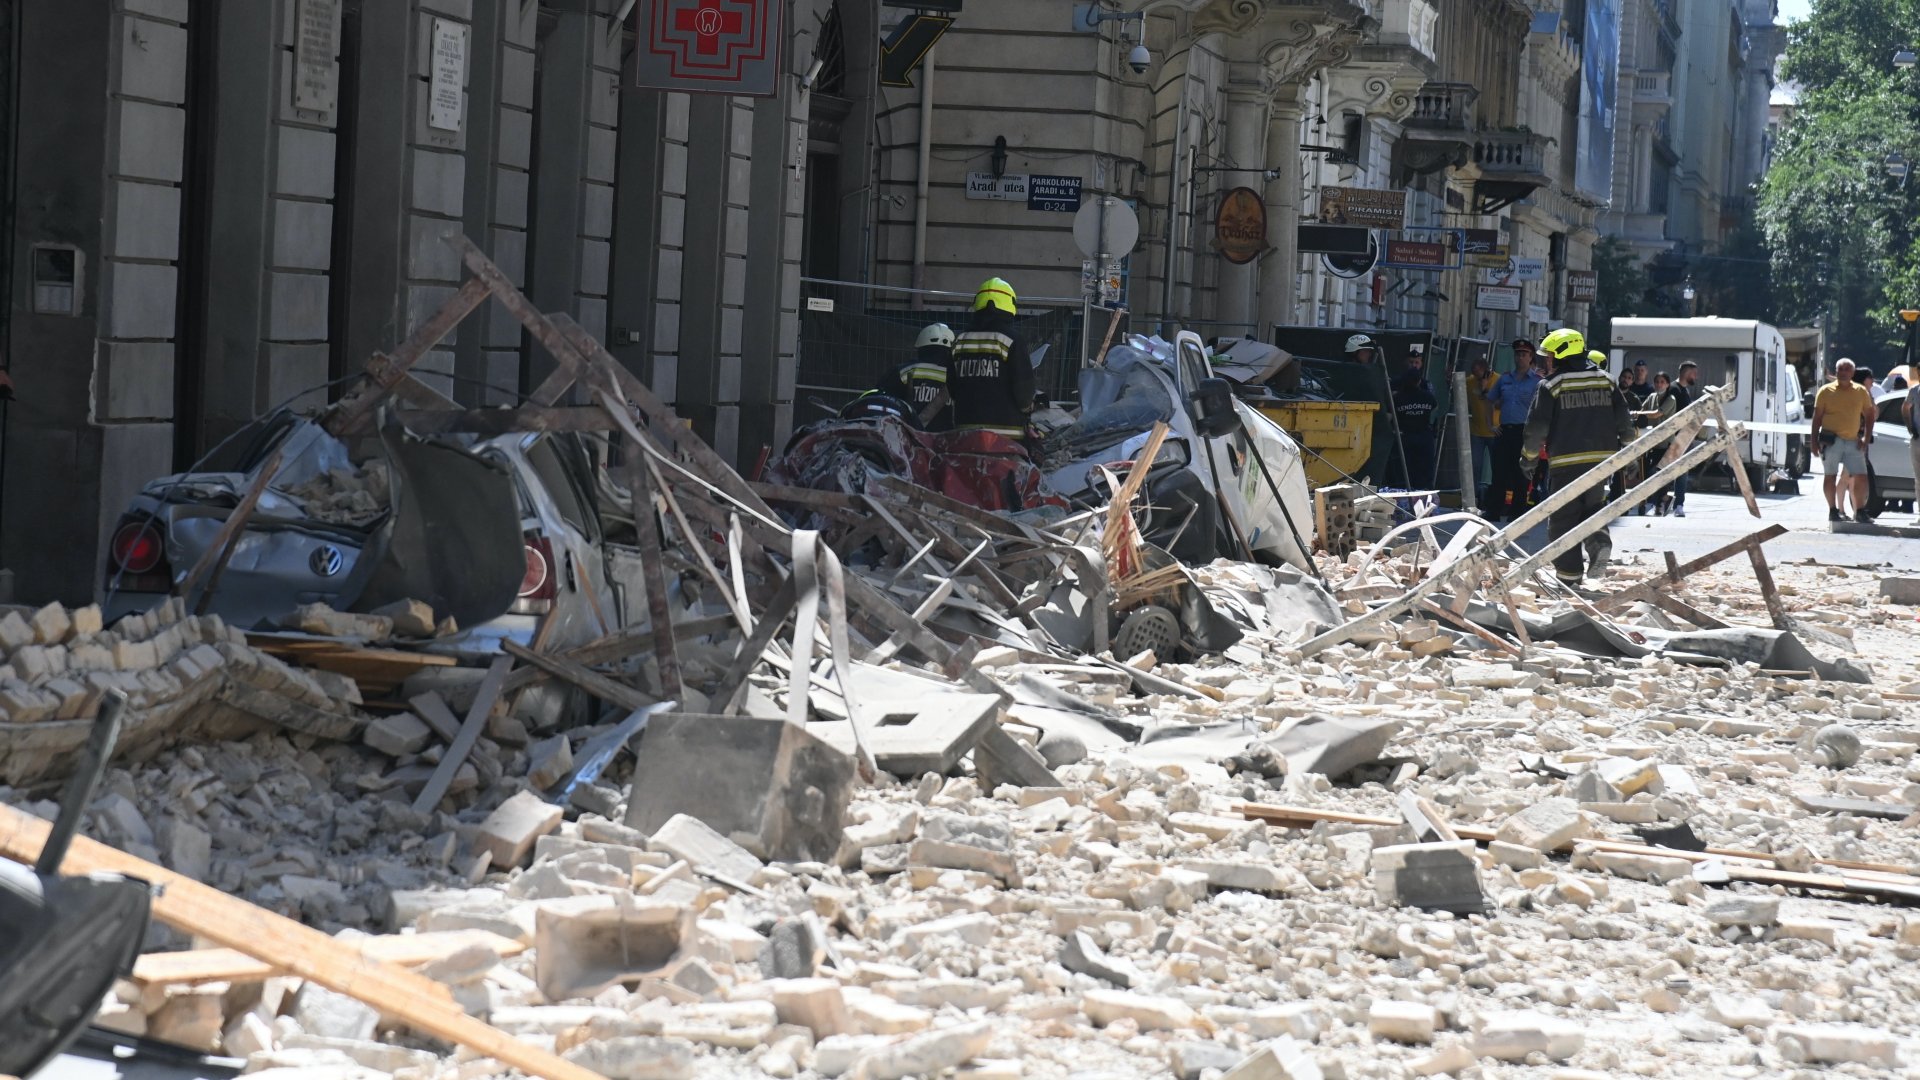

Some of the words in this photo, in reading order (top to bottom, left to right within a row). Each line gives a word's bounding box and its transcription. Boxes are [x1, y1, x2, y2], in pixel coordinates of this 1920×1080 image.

[969, 180, 997, 192] Aradi
[1004, 182, 1025, 193] utca
[1032, 177, 1081, 187] PARKOLÓHÁZ
[1034, 186, 1057, 195] ARADI
[1044, 202, 1066, 211] 0-24
[1568, 275, 1595, 286] Cactus
[1572, 286, 1595, 298] Juice
[1333, 415, 1347, 428] 63
